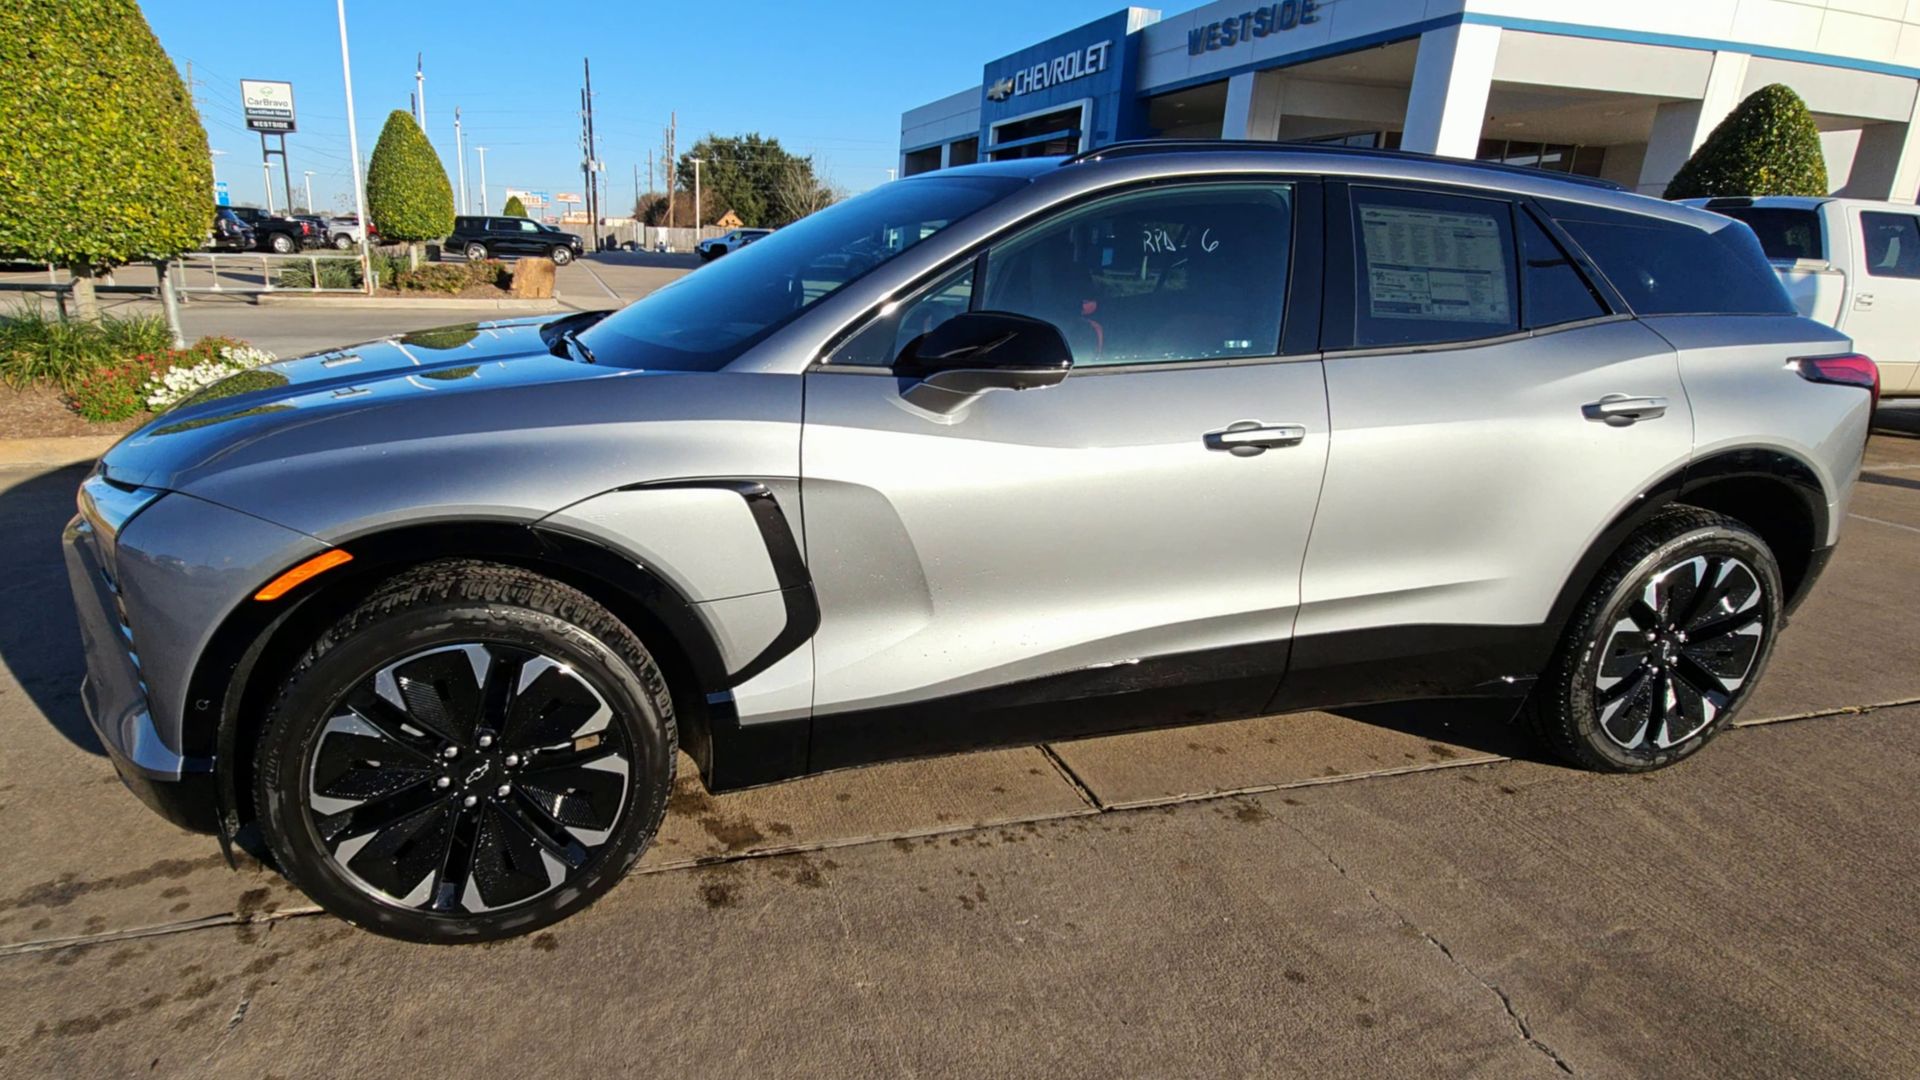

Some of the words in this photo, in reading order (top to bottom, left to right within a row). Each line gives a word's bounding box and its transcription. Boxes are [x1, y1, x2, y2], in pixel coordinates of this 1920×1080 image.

[1187, 0, 1319, 56] WESTSIDE
[1014, 40, 1112, 96] CHEVROLET
[247, 97, 289, 107] CarBravo
[248, 108, 275, 116] Certified
[252, 120, 288, 129] WESTSIDE
[1201, 228, 1219, 252] 6
